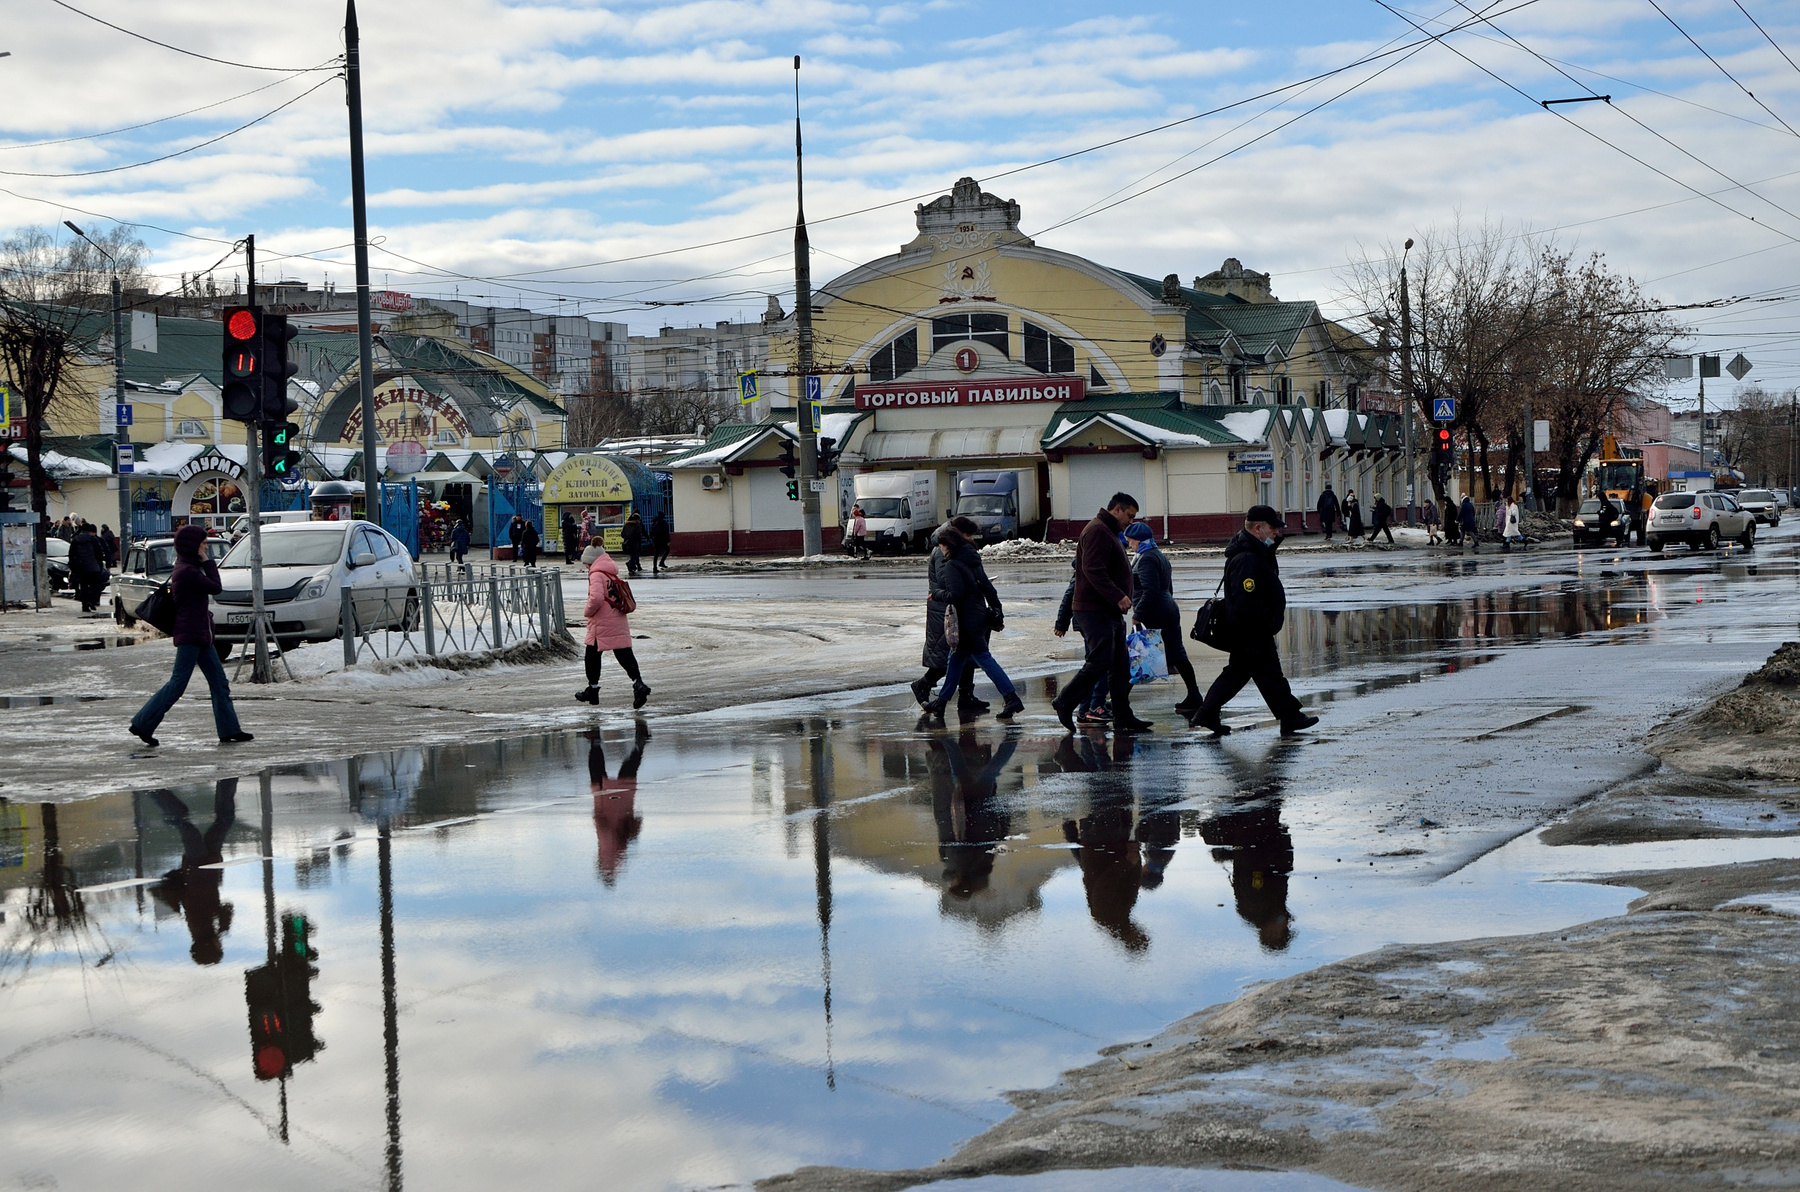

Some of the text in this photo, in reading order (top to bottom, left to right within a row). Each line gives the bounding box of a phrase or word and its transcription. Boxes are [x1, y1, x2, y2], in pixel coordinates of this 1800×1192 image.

[960, 351, 970, 368] 1
[862, 386, 1071, 407] ТОРГОВЫЙ ПАВИЛЬОН
[178, 456, 241, 482] ШАУРМА
[553, 458, 620, 483] ИЗГОТОВЛЕНИЕ
[565, 478, 608, 489] КЛЮЧЕЙ
[568, 490, 605, 499] ЗАТОЧКА
